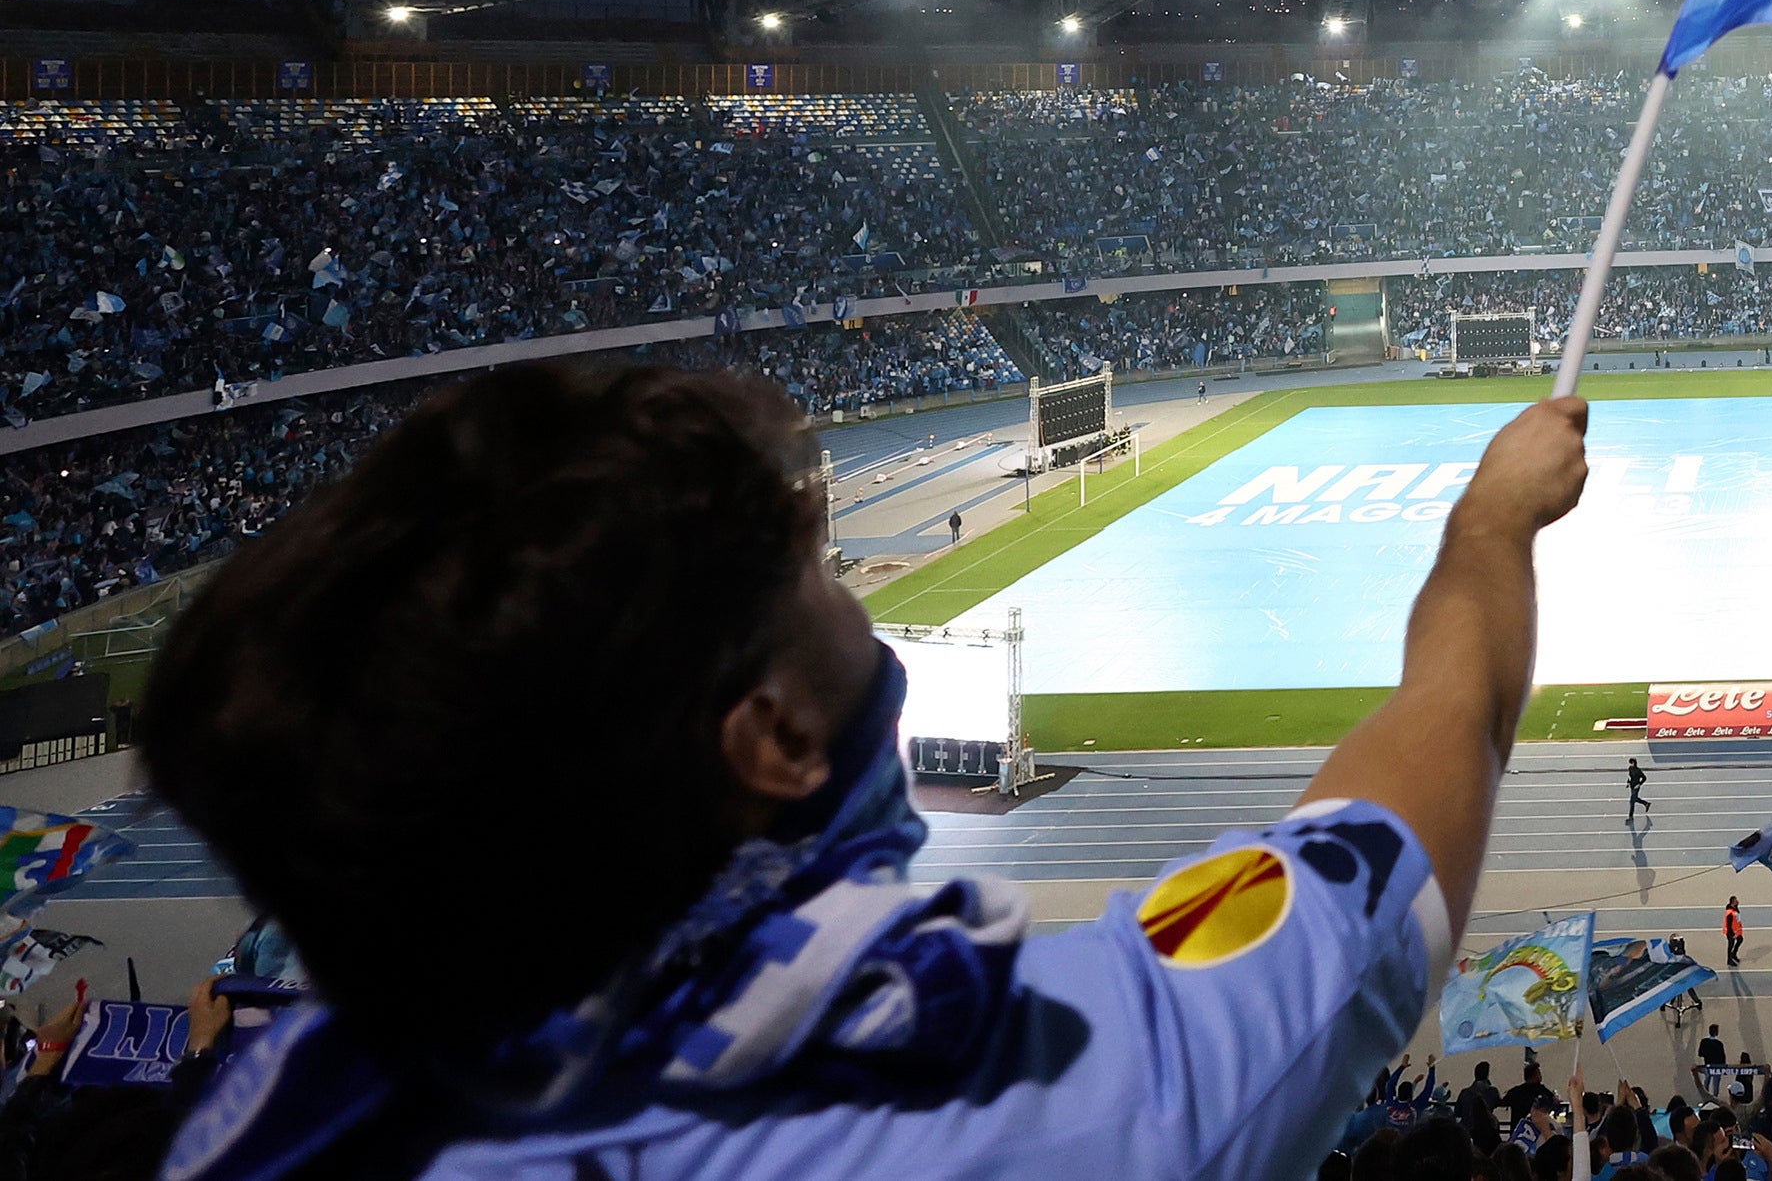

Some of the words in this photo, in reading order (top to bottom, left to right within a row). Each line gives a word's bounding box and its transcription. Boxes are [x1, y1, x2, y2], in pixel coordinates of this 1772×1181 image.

[1217, 454, 1703, 506] NAPLI
[1240, 500, 1458, 525] MAGG
[1651, 684, 1766, 716] Lete
[1655, 727, 1678, 738] Lete
[1683, 726, 1706, 737] Lete
[1711, 726, 1733, 737] Lete
[1740, 726, 1762, 736] Lete
[1709, 1068, 1739, 1076] NAPOLI
